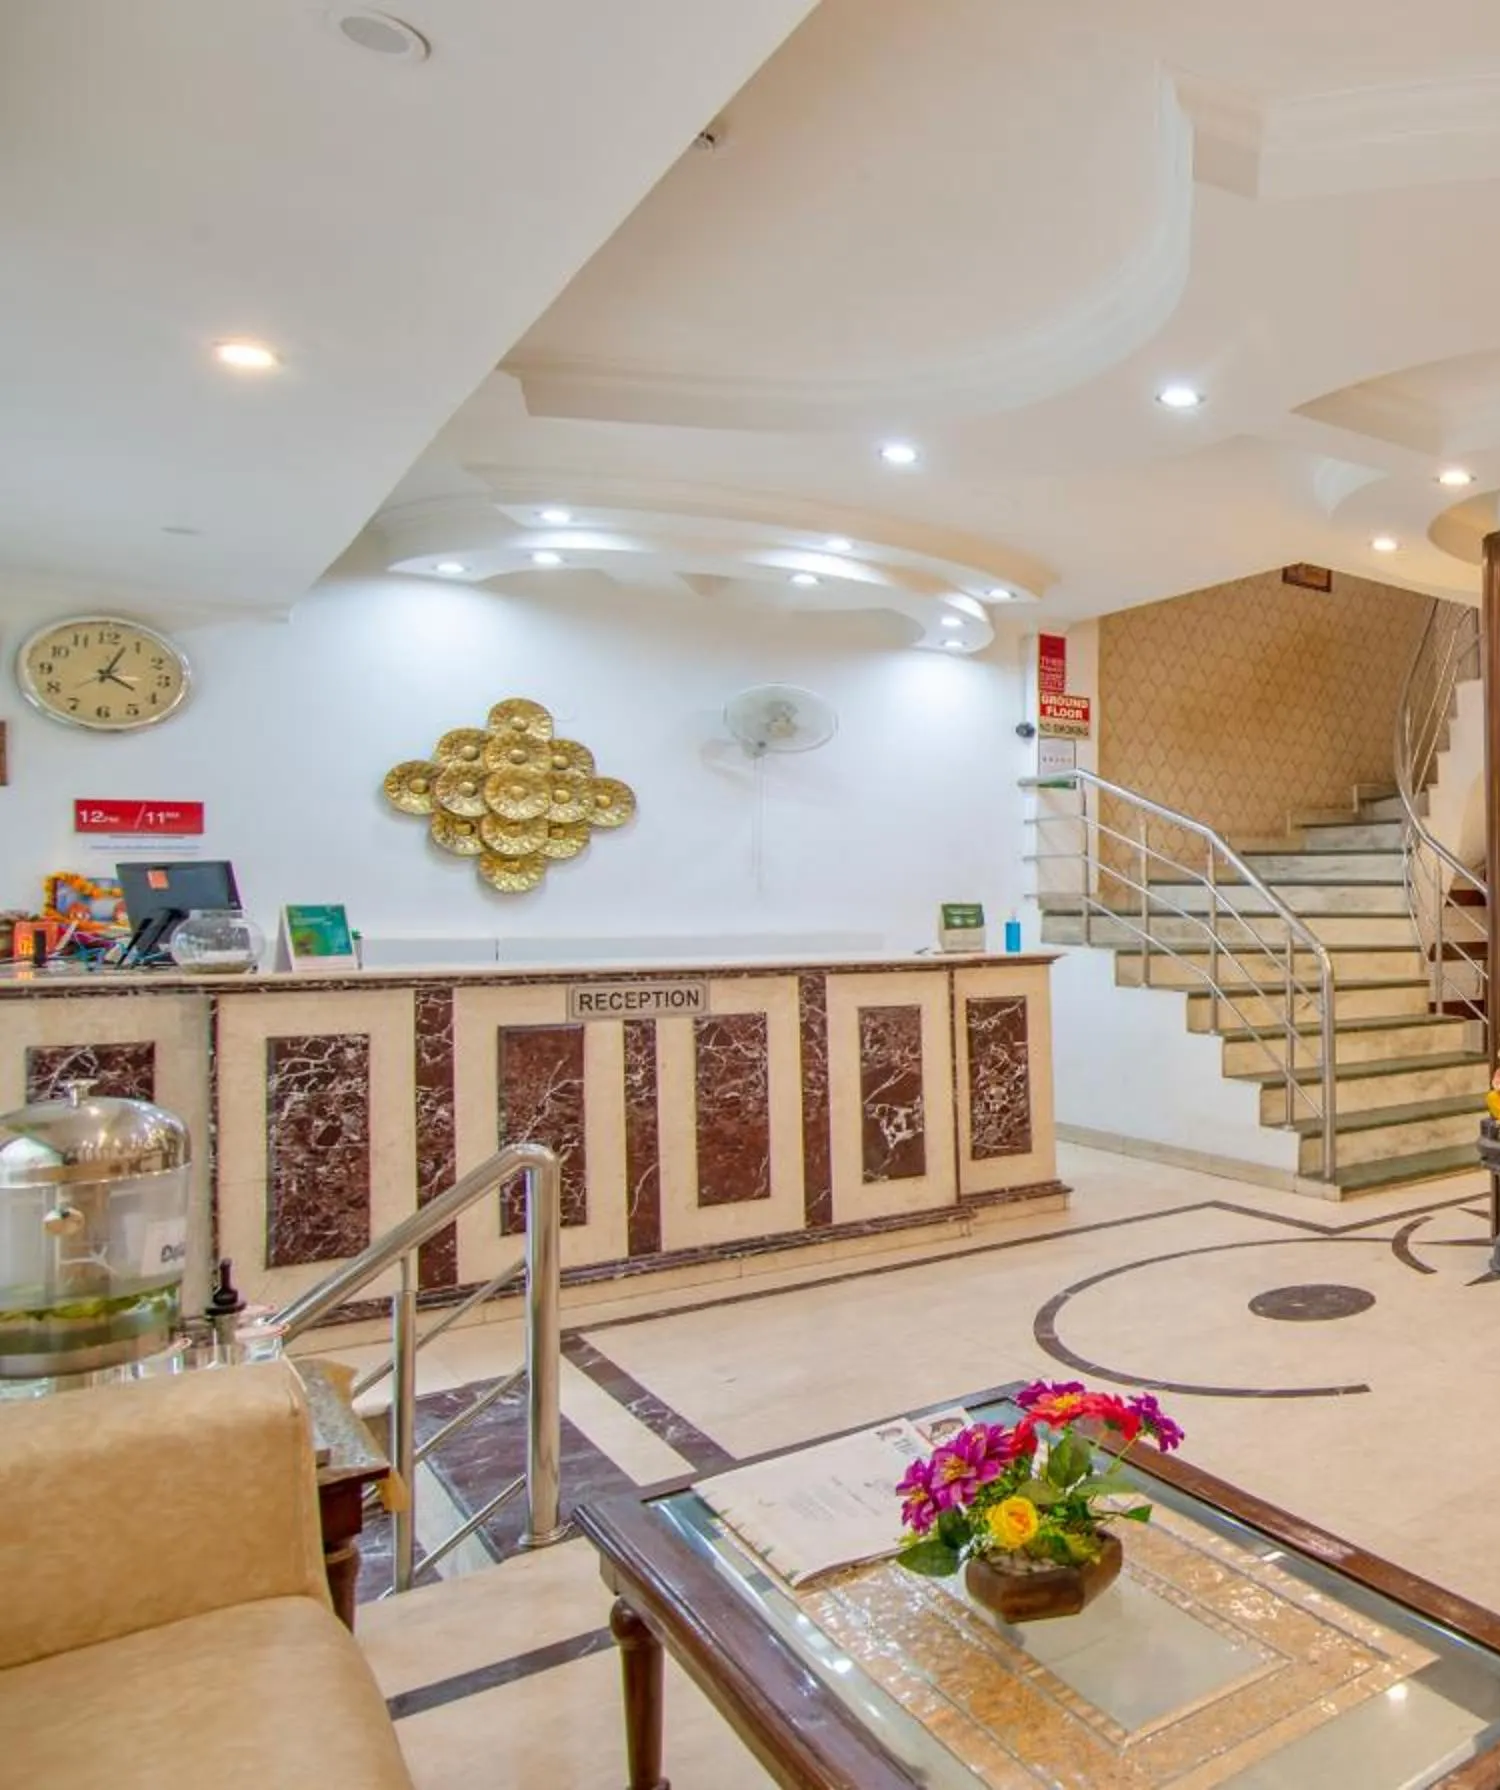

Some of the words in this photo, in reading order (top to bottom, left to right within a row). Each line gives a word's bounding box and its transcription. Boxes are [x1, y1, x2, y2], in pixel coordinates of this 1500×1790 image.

[73, 632, 89, 648] 11
[98, 631, 121, 645] 12
[52, 645, 69, 657] 10
[135, 641, 141, 654] 1
[39, 662, 53, 674] 9
[151, 657, 164, 670] 2
[47, 680, 61, 693] 8
[156, 674, 171, 688] 3
[67, 697, 81, 711] 7
[145, 692, 157, 704] 4
[1041, 695, 1089, 708] GROUND
[96, 706, 111, 718] 6
[126, 703, 139, 716] 5
[1046, 705, 1083, 719] FLOOR
[578, 989, 700, 1011] RECEPTION
